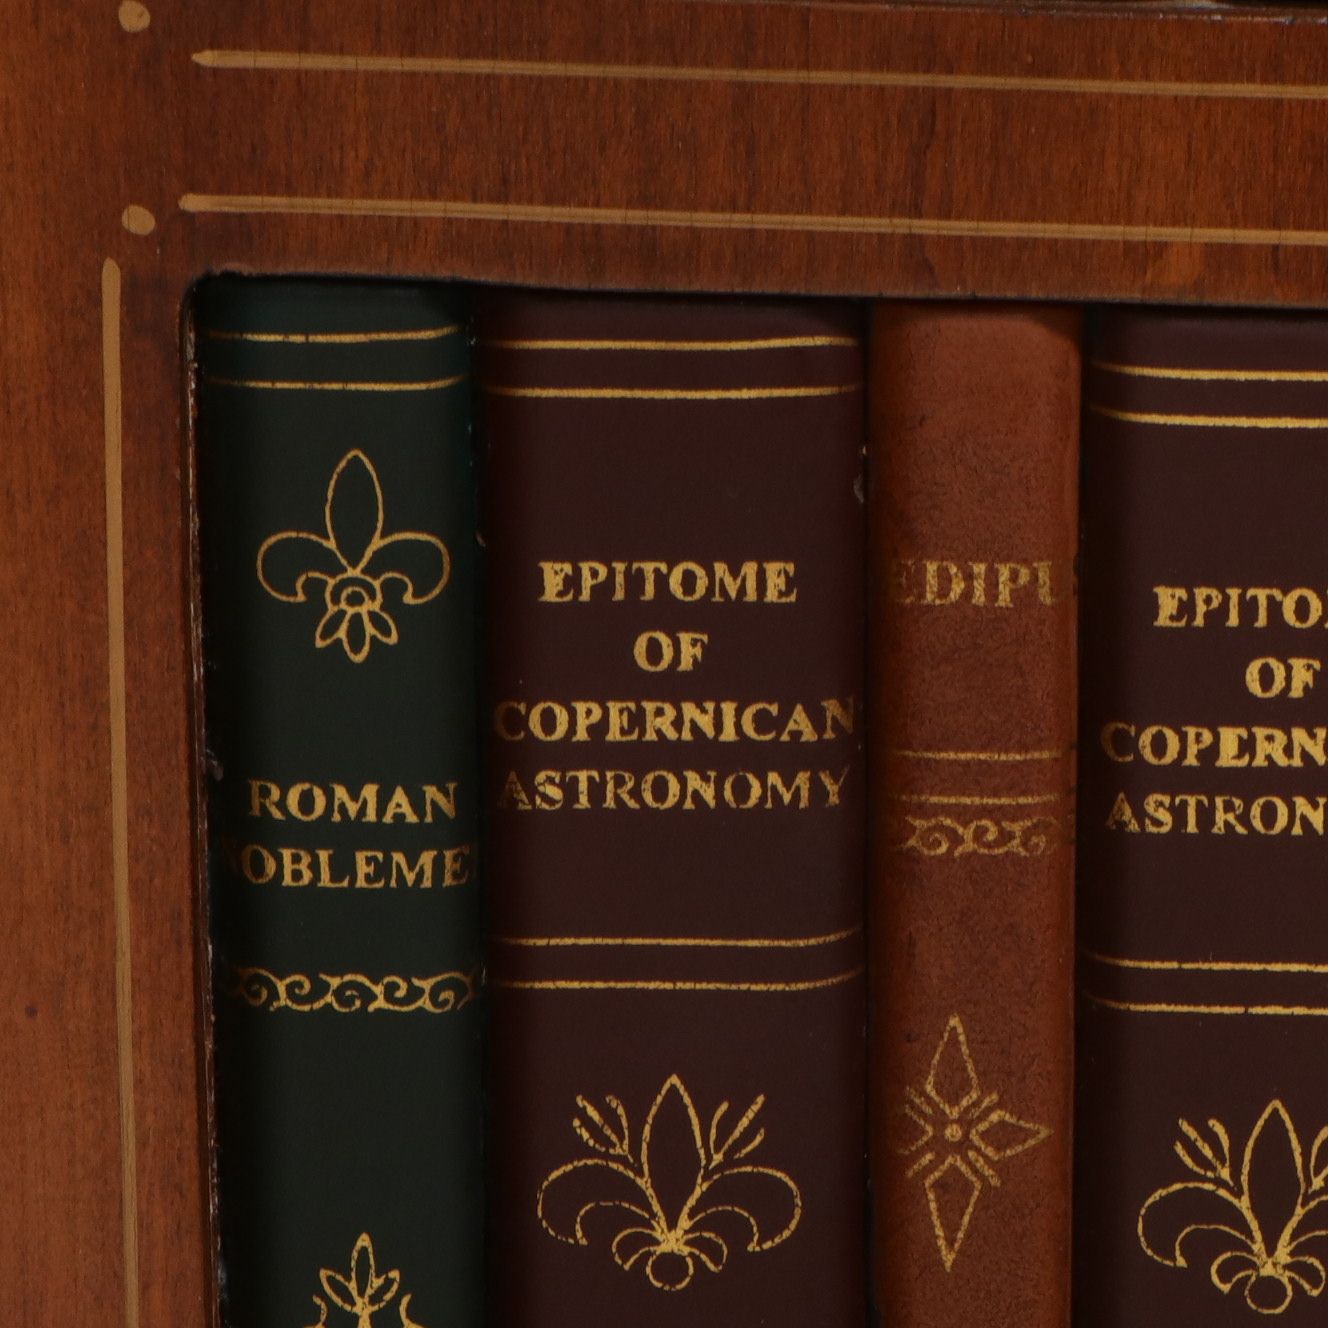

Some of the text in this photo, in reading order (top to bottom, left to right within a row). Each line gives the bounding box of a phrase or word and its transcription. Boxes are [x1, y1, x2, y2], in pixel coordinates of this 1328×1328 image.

[537, 560, 797, 603] EPITOME
[633, 630, 709, 672] OF
[1245, 657, 1321, 699] OF
[496, 696, 854, 743] COPERNICAN
[248, 778, 458, 824] ROMAN
[500, 765, 850, 811] ASTRONOMY
[226, 842, 473, 889] OBLEME
